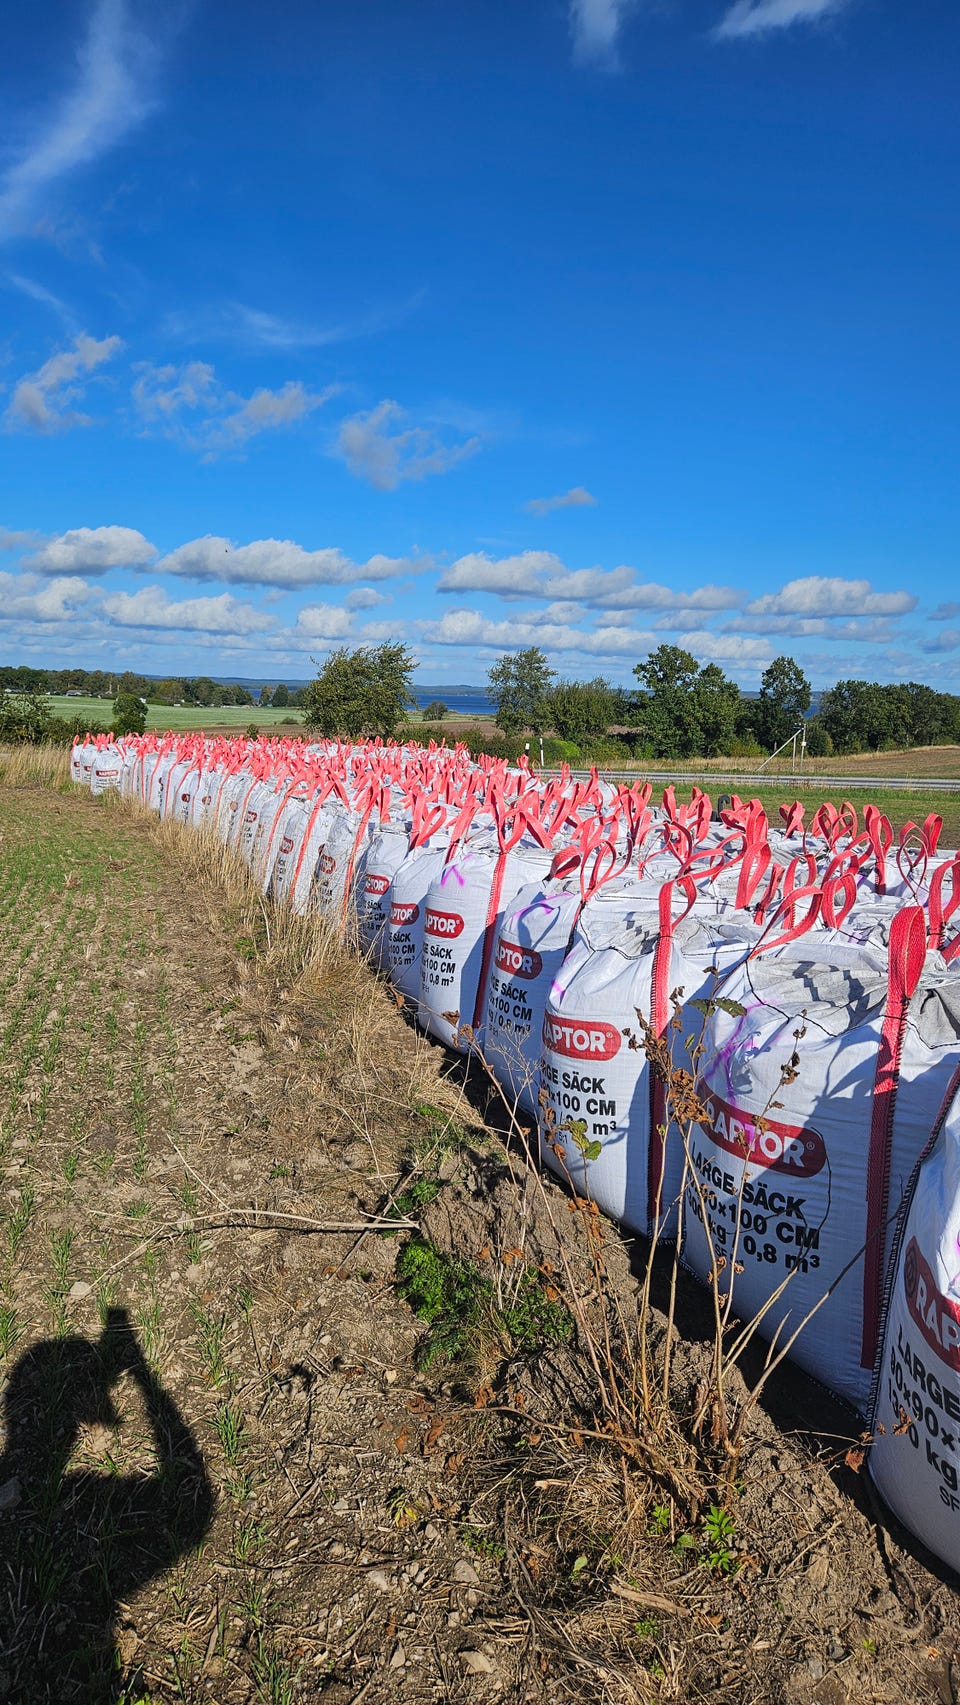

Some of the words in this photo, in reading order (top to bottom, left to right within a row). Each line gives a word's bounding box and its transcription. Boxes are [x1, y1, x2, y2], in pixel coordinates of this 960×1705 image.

[391, 908, 413, 921] PTOR
[401, 944, 415, 954] CM
[430, 945, 453, 960] SÄCK
[440, 961, 456, 974] CM
[429, 973, 440, 986] 0,8
[441, 976, 454, 987] m³
[500, 982, 528, 1004] SÄCK
[512, 1005, 533, 1021] CM
[562, 1071, 606, 1095] SÄCK
[586, 1098, 616, 1117] CM
[592, 1120, 617, 1135] m³
[707, 1101, 806, 1168] RAPTOR
[692, 1141, 736, 1196] LARGE
[740, 1181, 807, 1220] SÄCK
[775, 1221, 820, 1250] CM
[743, 1235, 777, 1264] 0,8
[785, 1253, 820, 1273] m³
[897, 1323, 960, 1425] LARGE
[888, 1377, 919, 1449] 130
[925, 1438, 959, 1492] kg
